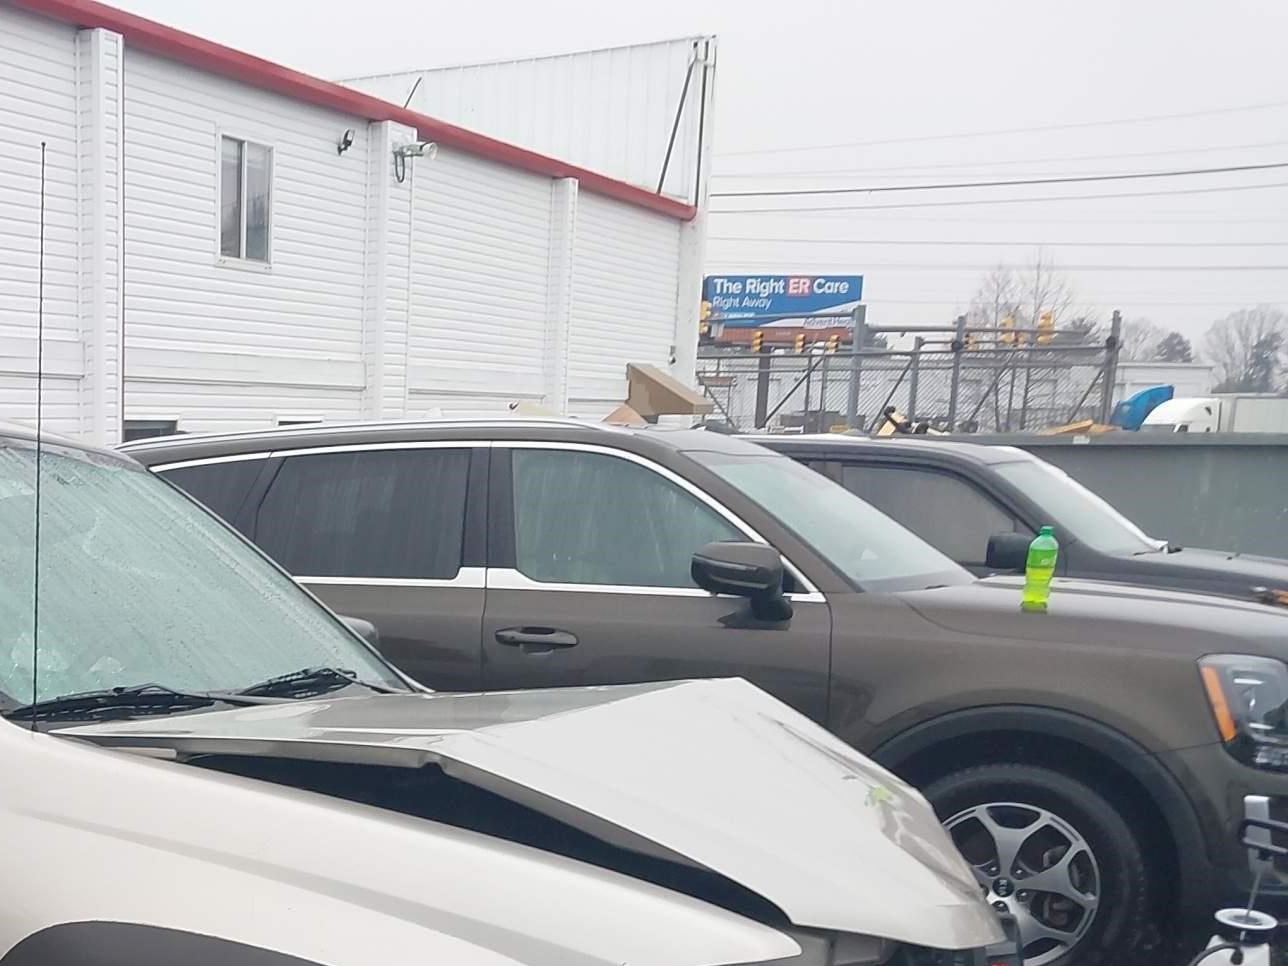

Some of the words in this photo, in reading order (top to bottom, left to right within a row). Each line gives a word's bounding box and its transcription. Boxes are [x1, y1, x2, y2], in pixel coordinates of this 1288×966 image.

[713, 278, 743, 294] The
[745, 278, 785, 298] Right
[788, 278, 811, 294] ER
[813, 278, 849, 294] Care
[712, 296, 740, 311] Right
[741, 296, 772, 311] Away
